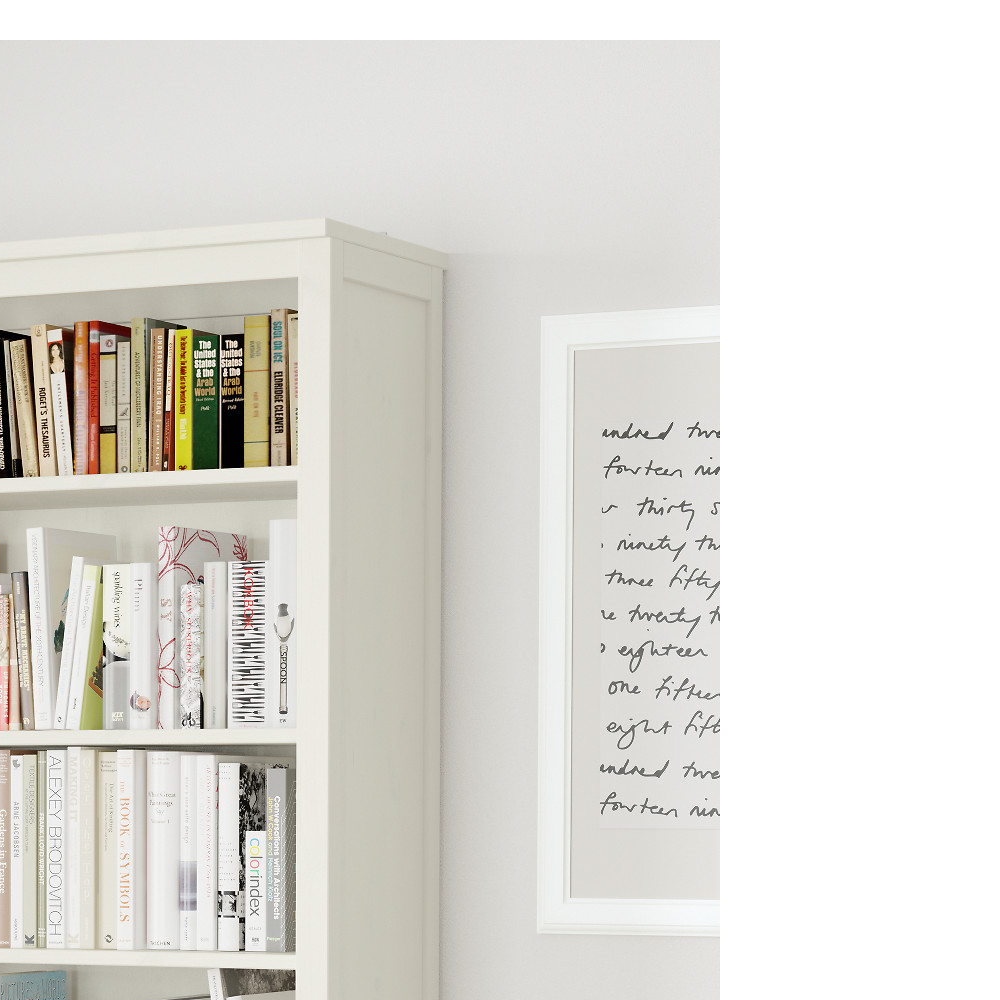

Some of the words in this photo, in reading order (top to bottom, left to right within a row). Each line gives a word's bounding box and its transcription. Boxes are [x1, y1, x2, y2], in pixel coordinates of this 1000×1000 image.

[273, 321, 282, 339] SOUL
[194, 349, 216, 359] United
[199, 341, 211, 349] The
[221, 349, 242, 358] United
[225, 340, 238, 349] The
[273, 340, 282, 351] ON
[194, 358, 216, 368] States
[221, 358, 243, 368] States
[273, 352, 283, 363] ICE
[196, 368, 201, 377] &
[203, 368, 214, 377] the
[197, 378, 213, 387] Arab
[223, 368, 228, 377] &
[229, 368, 240, 376] the
[223, 377, 240, 386] Arab
[195, 387, 215, 396] World
[222, 385, 242, 396] World
[274, 371, 284, 403] ELDRIDGE
[38, 387, 49, 416] ROGET'S
[274, 404, 284, 434] CLEAVER
[41, 417, 51, 458] THESAURUS
[604, 455, 682, 479] fourteen
[637, 497, 694, 531] thirty
[617, 534, 686, 562] ninety
[112, 571, 122, 604] sparkling
[605, 569, 653, 586] three
[669, 564, 720, 601] fifty
[243, 568, 254, 630] KOKBOK
[114, 606, 122, 628] wines
[629, 604, 701, 638] twenty
[618, 628, 708, 673] eighteen
[608, 681, 641, 694] one
[606, 718, 672, 750] eight
[48, 755, 62, 821] ALEXEY
[600, 792, 678, 818] fourteen
[273, 795, 281, 856] Conversations
[0, 850, 7, 860] in
[273, 857, 281, 876] with
[0, 862, 7, 894] France
[48, 826, 62, 936] BRODOVITCH
[249, 838, 263, 917] colorindex
[273, 877, 281, 920] Architects
